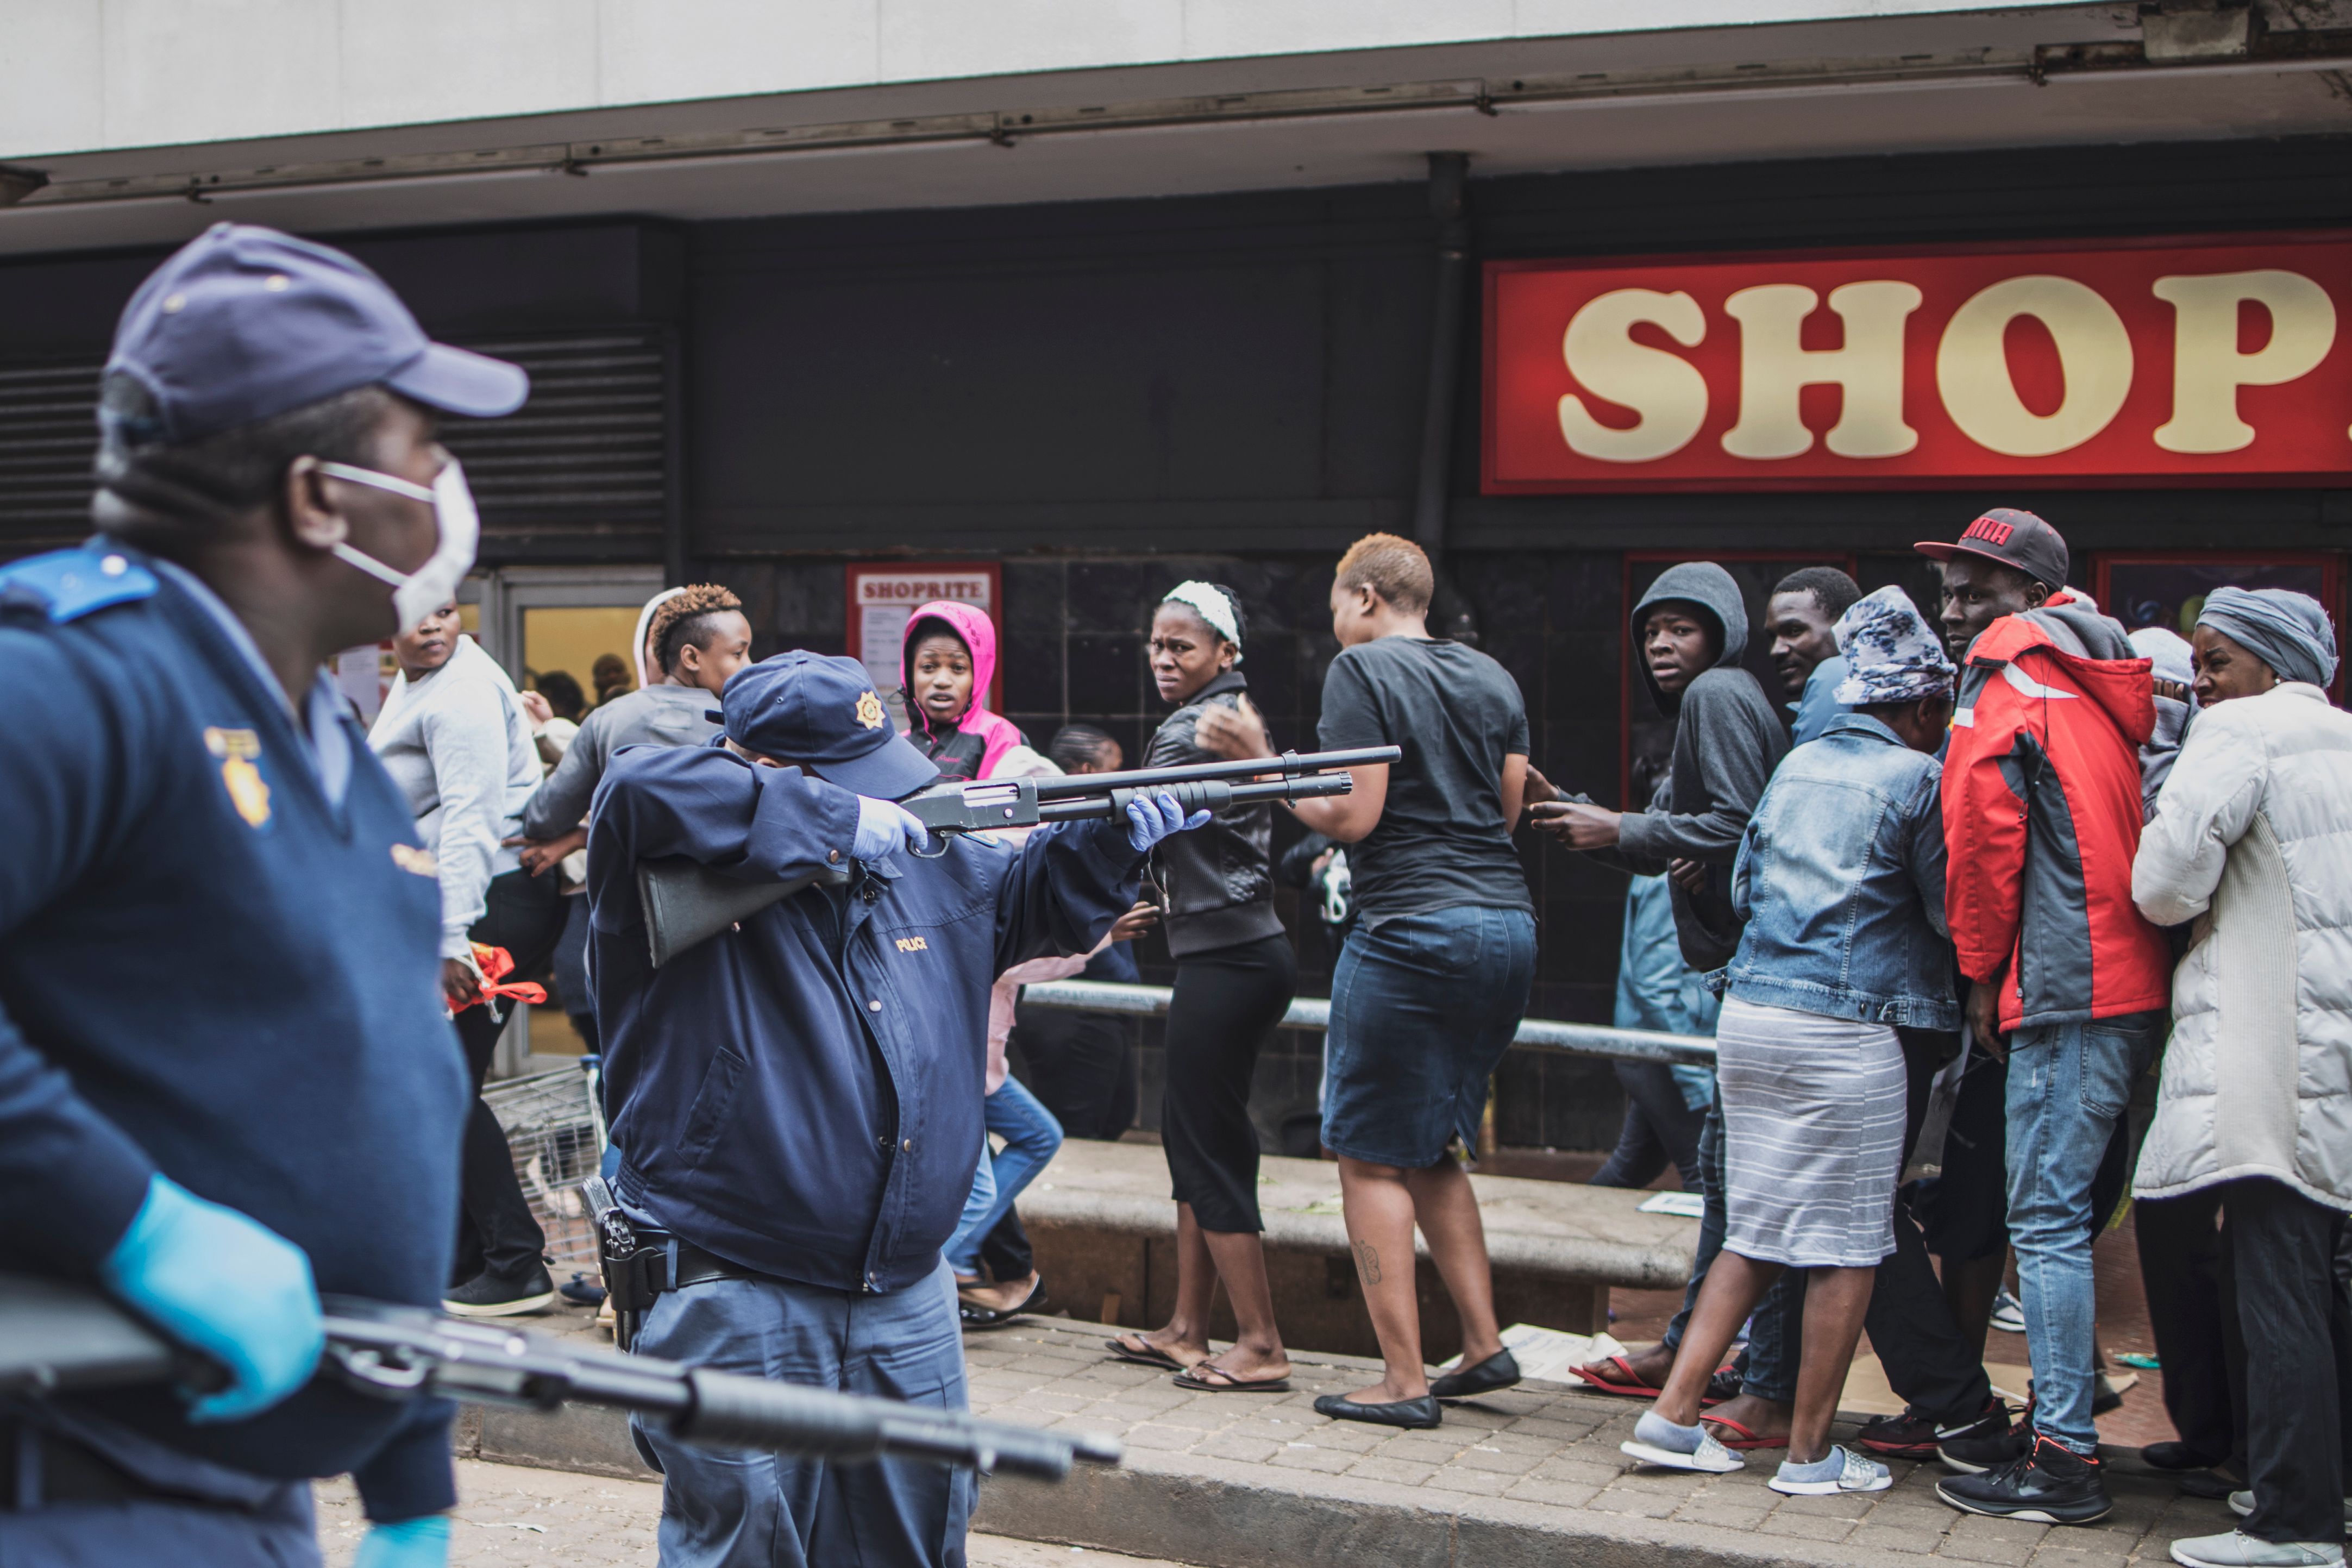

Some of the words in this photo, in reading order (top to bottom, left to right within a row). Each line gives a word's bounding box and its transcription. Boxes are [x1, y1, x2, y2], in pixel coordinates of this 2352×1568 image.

[1558, 270, 2352, 462] SHOP
[864, 581, 983, 598] SHOPRITE
[895, 936, 928, 953] POLICE
